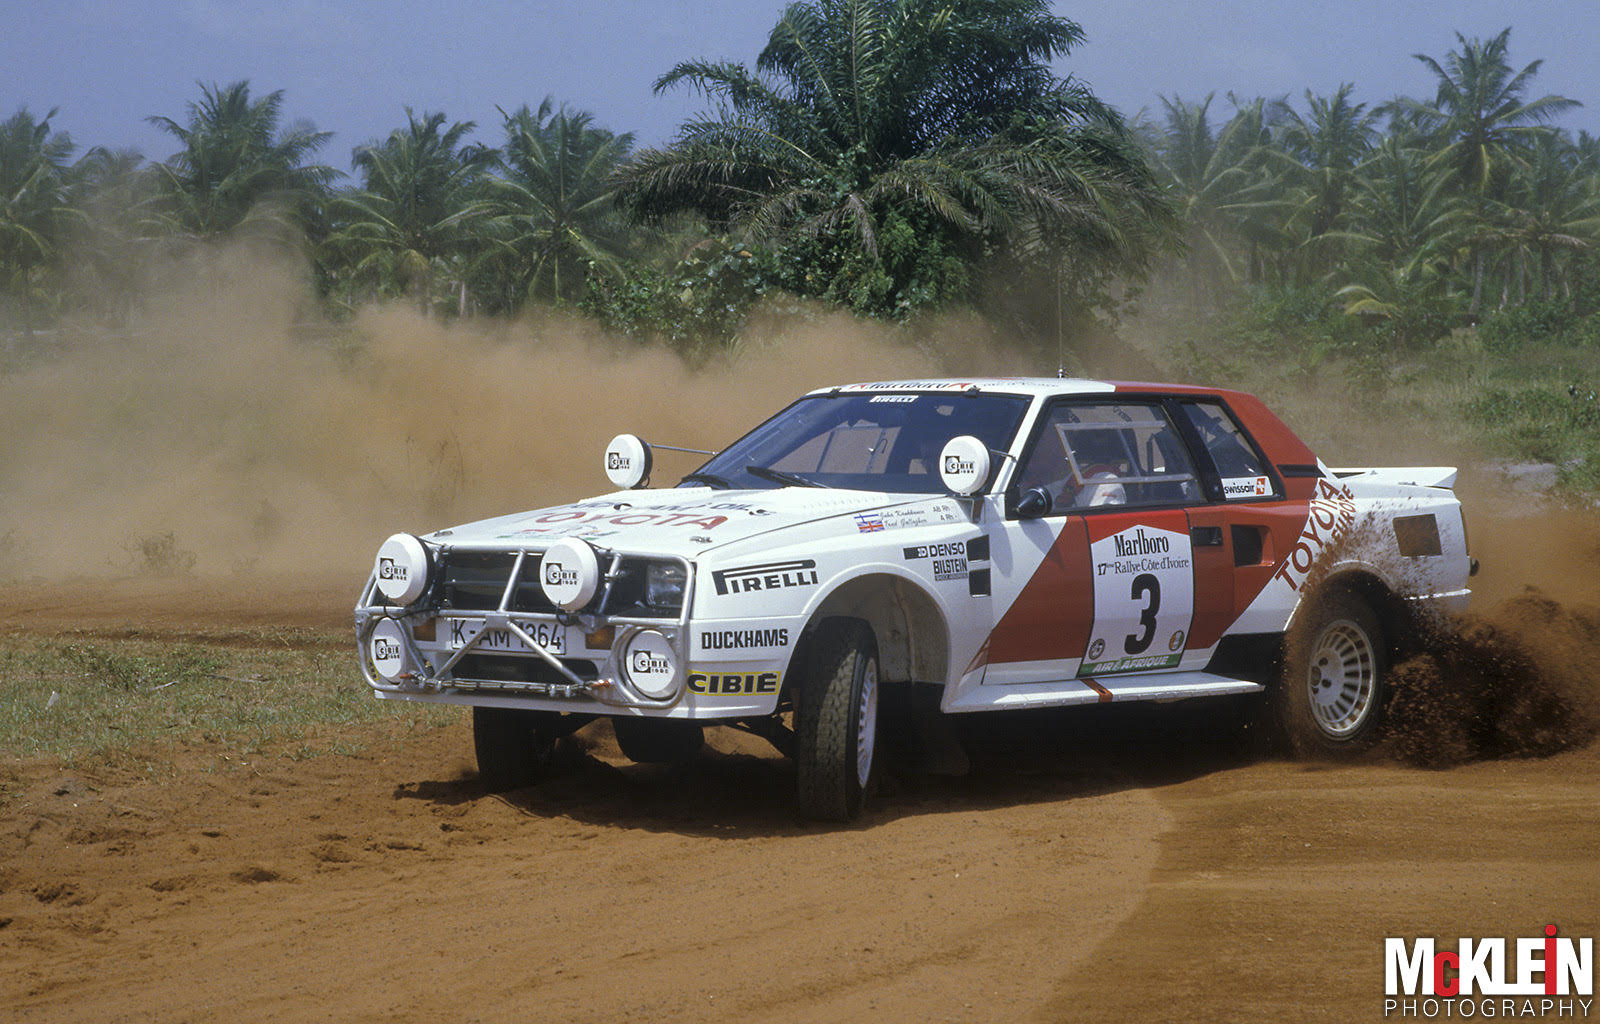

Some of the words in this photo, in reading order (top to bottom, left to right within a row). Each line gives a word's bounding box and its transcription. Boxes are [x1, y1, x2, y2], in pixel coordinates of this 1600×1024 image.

[869, 395, 919, 403] PIRELLI
[1224, 482, 1255, 494] swissair
[532, 511, 728, 530] OYOTA
[1331, 484, 1356, 539] EUROPE
[1114, 529, 1169, 557] Marlboro
[1275, 479, 1340, 591] TOYOTA
[929, 542, 965, 557] DENSO
[933, 558, 968, 574] BILSTEIN
[1115, 561, 1141, 575] Rallye
[712, 559, 818, 595] PIRELLI
[1124, 573, 1161, 655] 3
[520, 622, 562, 650] 1364
[701, 629, 789, 650] DUCKHAMS
[1092, 662, 1114, 673] AIR
[1121, 656, 1169, 670] AFRIQUE
